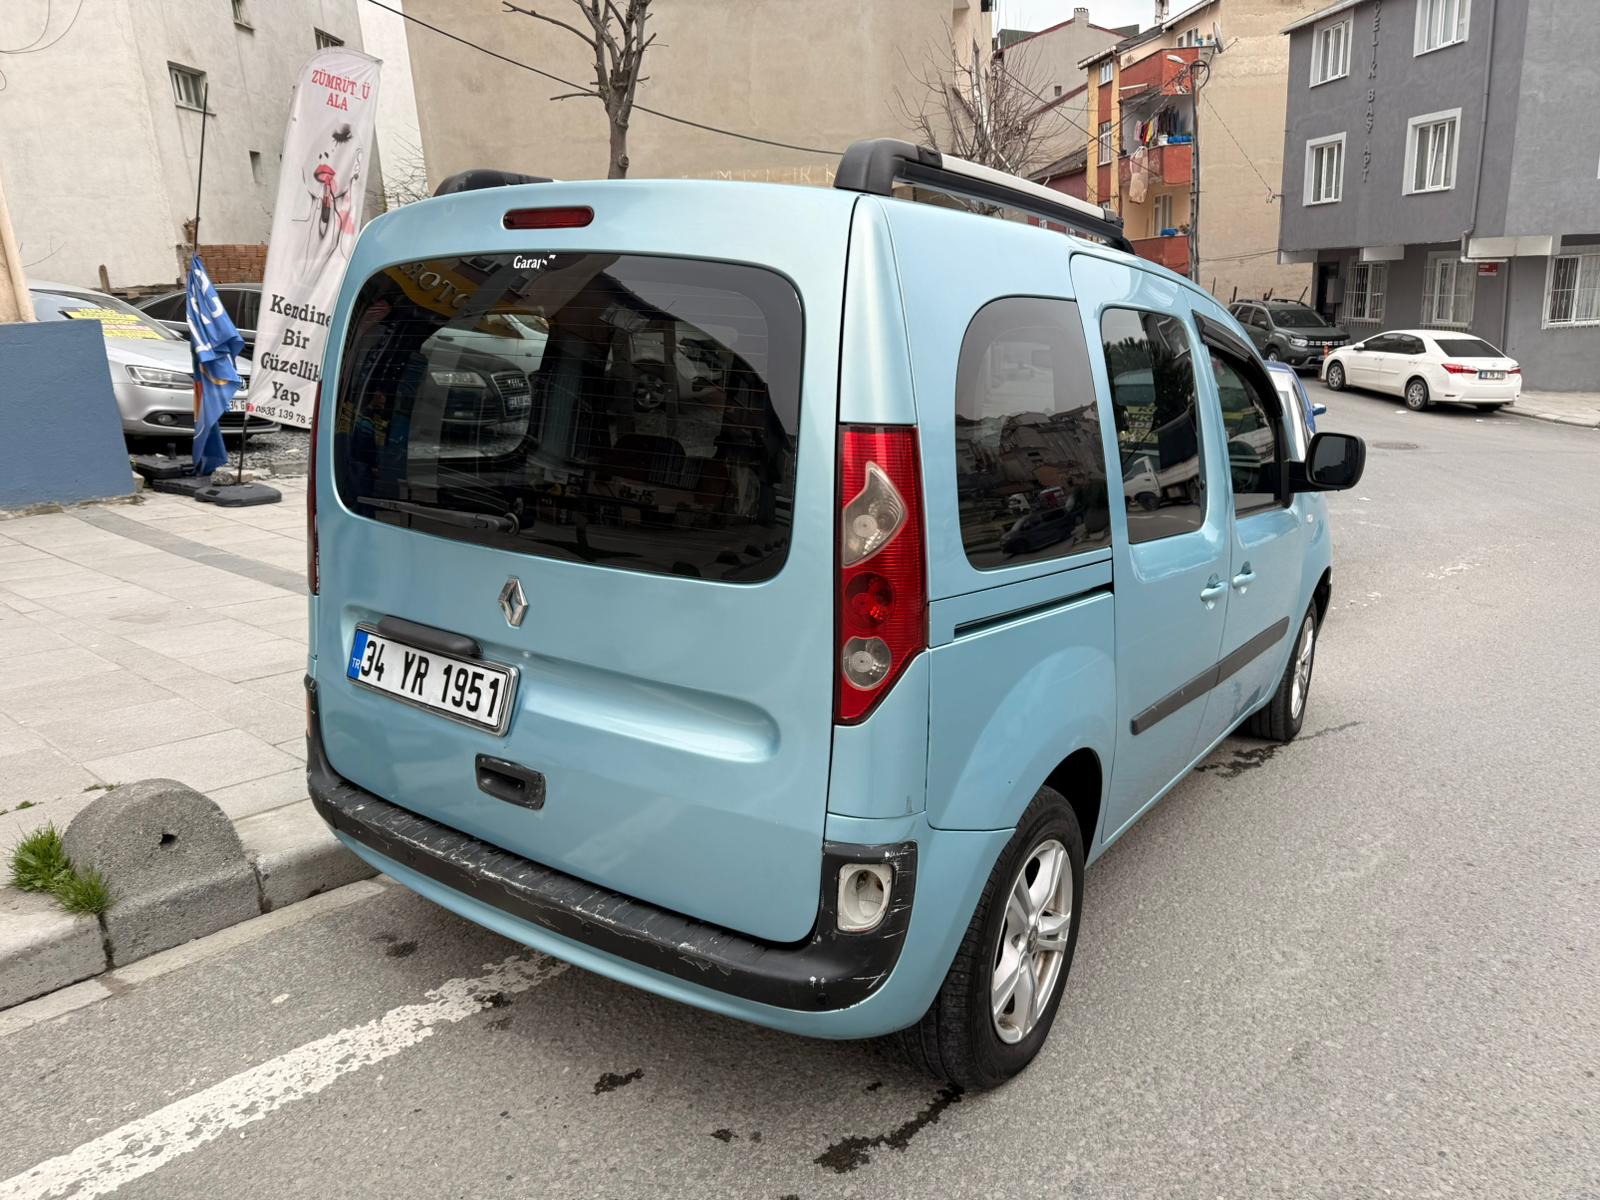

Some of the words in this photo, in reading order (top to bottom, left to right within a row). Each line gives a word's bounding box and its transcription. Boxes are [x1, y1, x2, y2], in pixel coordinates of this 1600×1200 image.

[311, 68, 358, 96] ZÜMRÜT
[326, 92, 348, 111] ALA
[282, 329, 310, 349] Bir
[272, 381, 300, 406] Yap
[278, 408, 294, 420] 139
[296, 413, 306, 424] 78
[352, 657, 361, 670] TR
[361, 640, 386, 681] 34
[400, 651, 430, 696] YR
[441, 664, 500, 717] 1951
